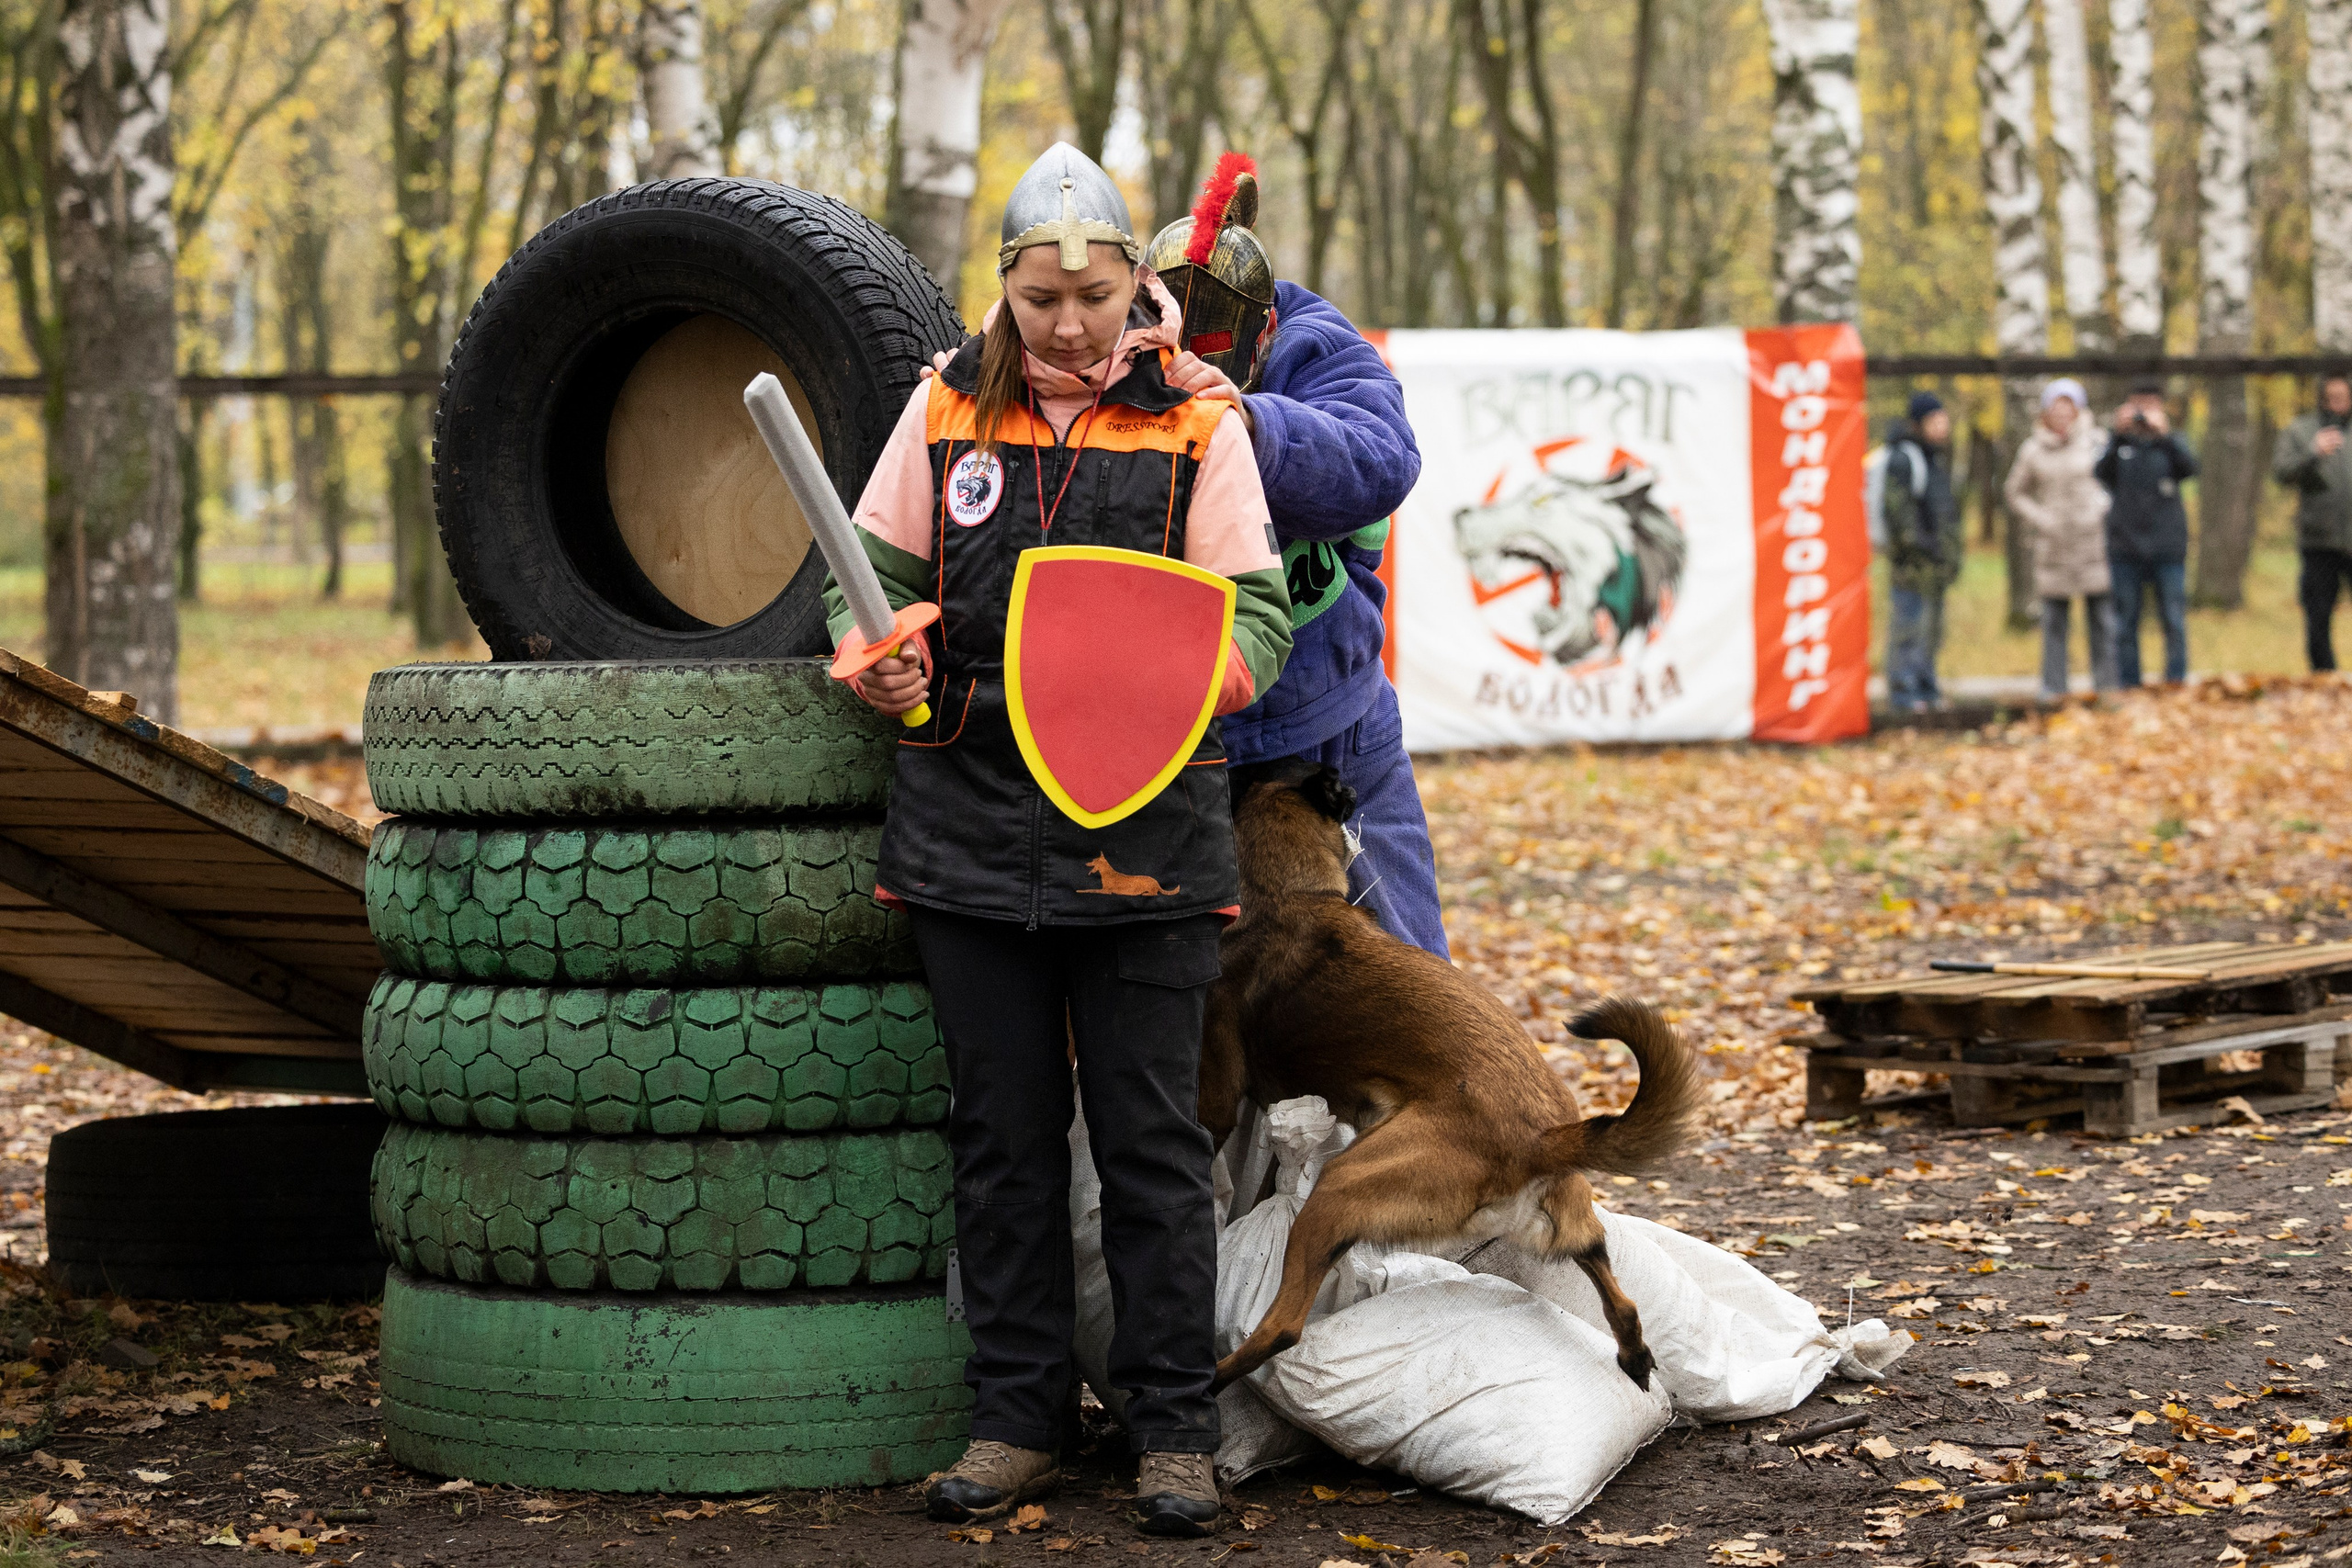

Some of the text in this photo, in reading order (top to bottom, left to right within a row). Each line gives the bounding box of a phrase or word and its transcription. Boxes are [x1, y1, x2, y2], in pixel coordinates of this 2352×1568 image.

[1459, 368, 1696, 445] ВАРЯГ
[1105, 421, 1179, 434] DRESSPORT
[955, 504, 987, 515] ВОЛОГДА
[1475, 663, 1683, 719] ВОЛОГДА
